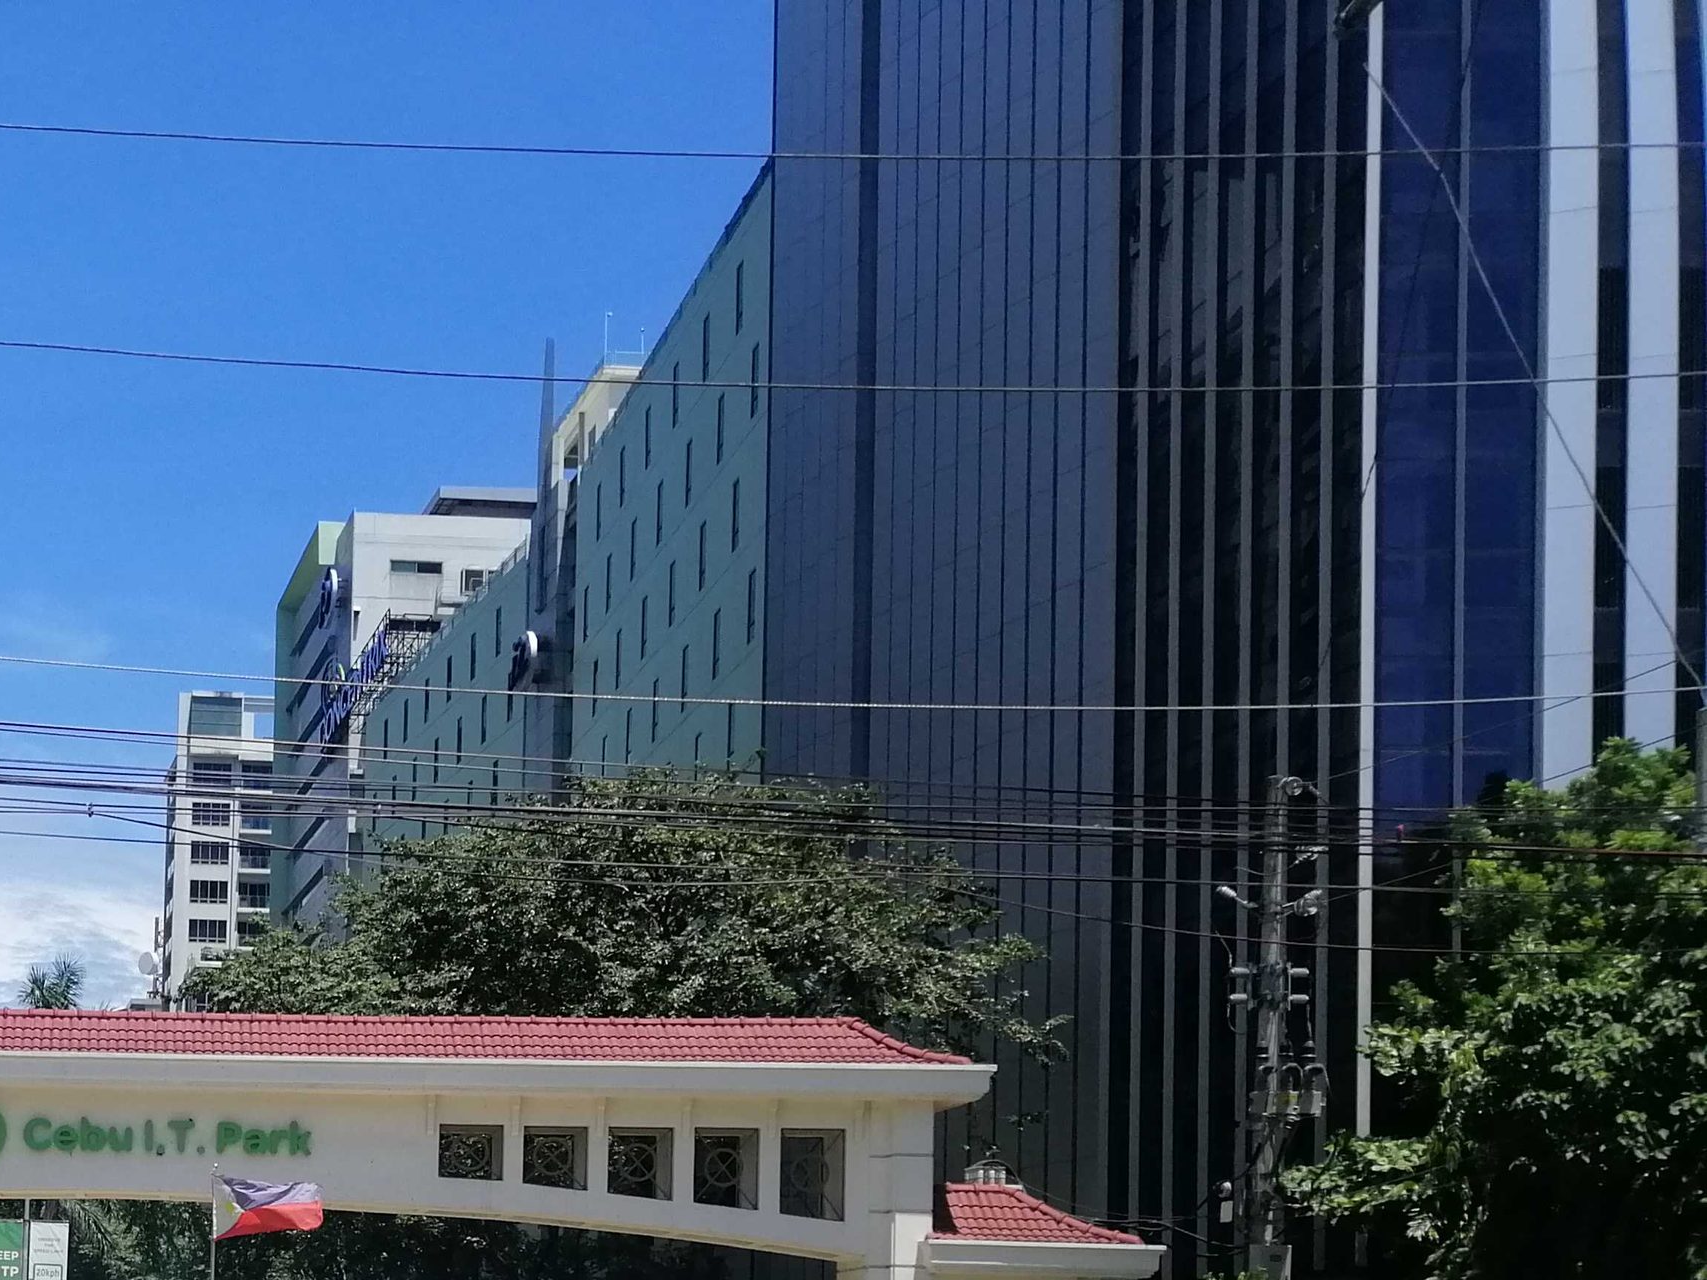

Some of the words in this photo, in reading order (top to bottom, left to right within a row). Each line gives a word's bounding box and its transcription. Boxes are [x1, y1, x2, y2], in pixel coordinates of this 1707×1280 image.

[23, 1116, 133, 1154] Cebu
[144, 1119, 205, 1154] I.T.
[216, 1120, 312, 1155] Park
[36, 1268, 60, 1278] 20kph
